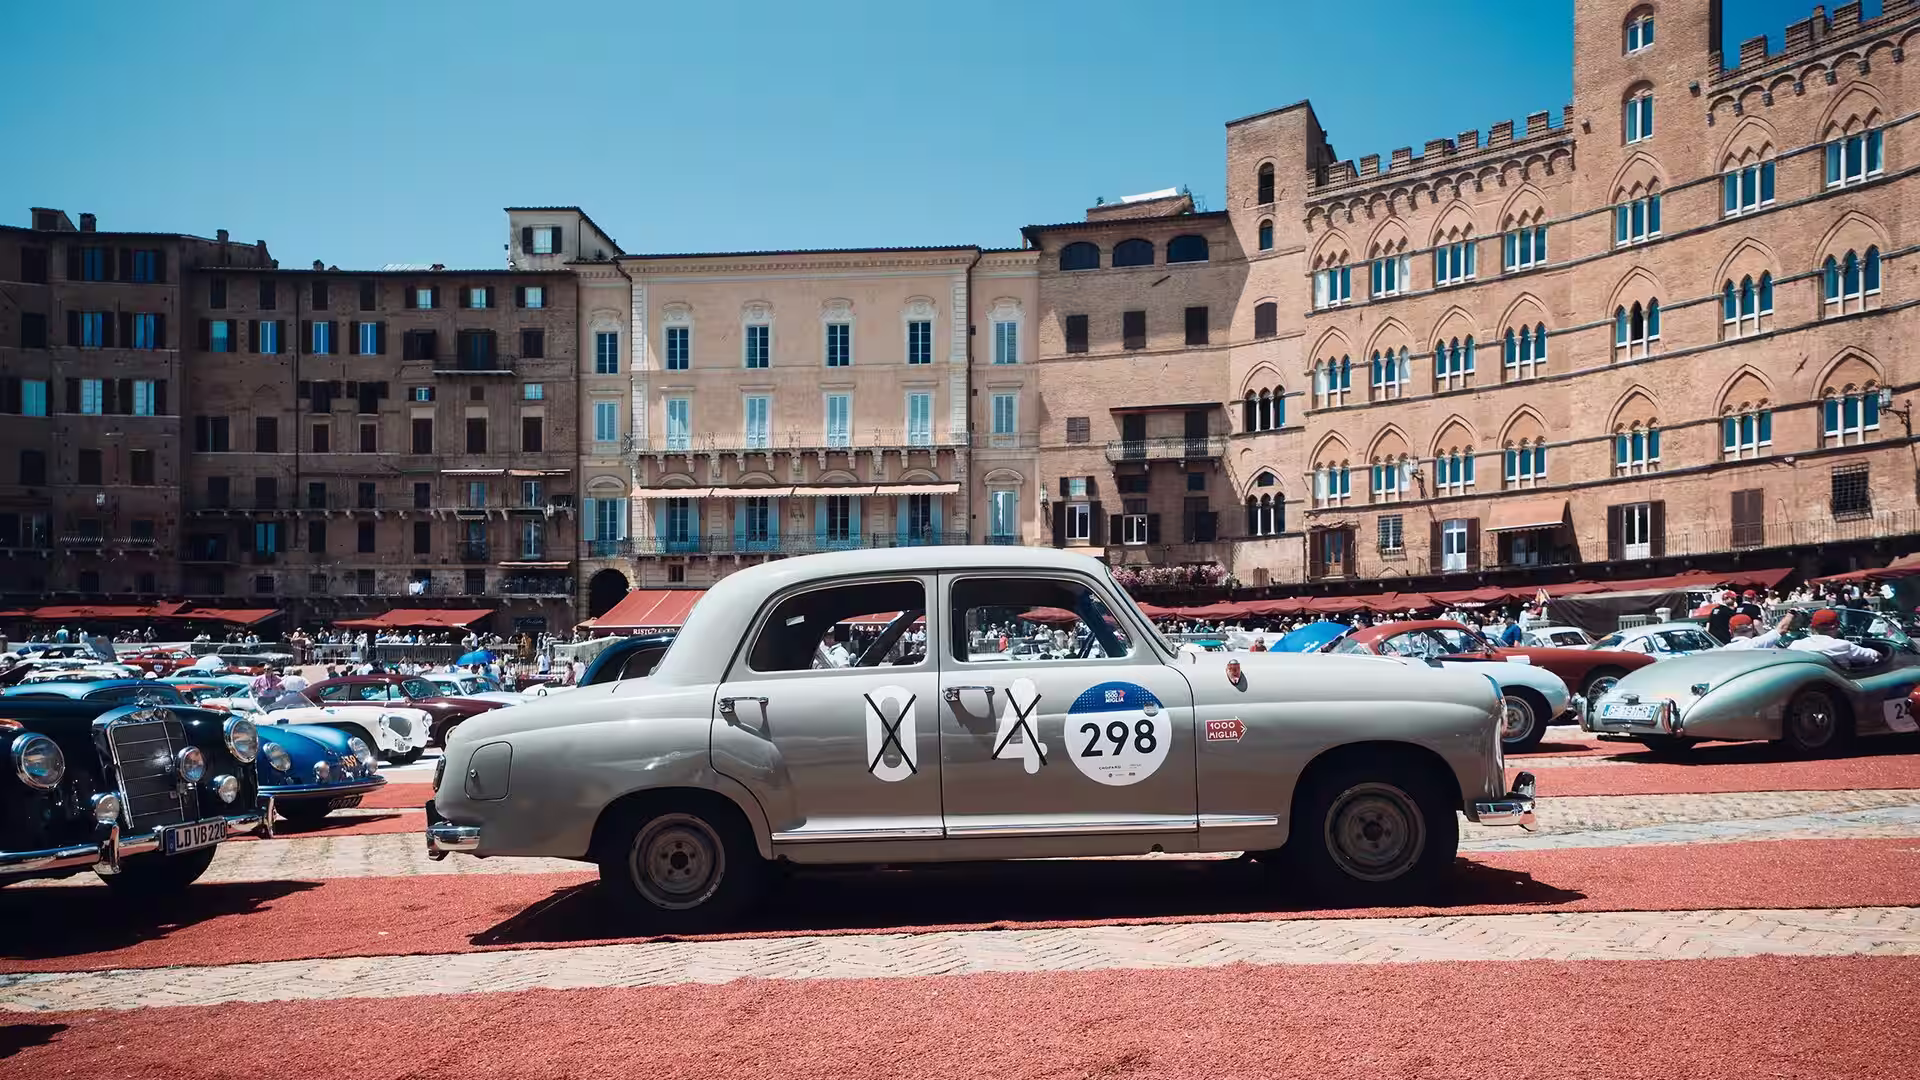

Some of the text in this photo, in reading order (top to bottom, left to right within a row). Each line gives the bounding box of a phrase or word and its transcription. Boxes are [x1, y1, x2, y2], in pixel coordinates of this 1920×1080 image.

[993, 677, 1048, 774] 4
[1209, 730, 1238, 739] MIGLIA
[1210, 721, 1236, 730] 1000
[1079, 718, 1158, 758] 298
[176, 828, 192, 849] LD
